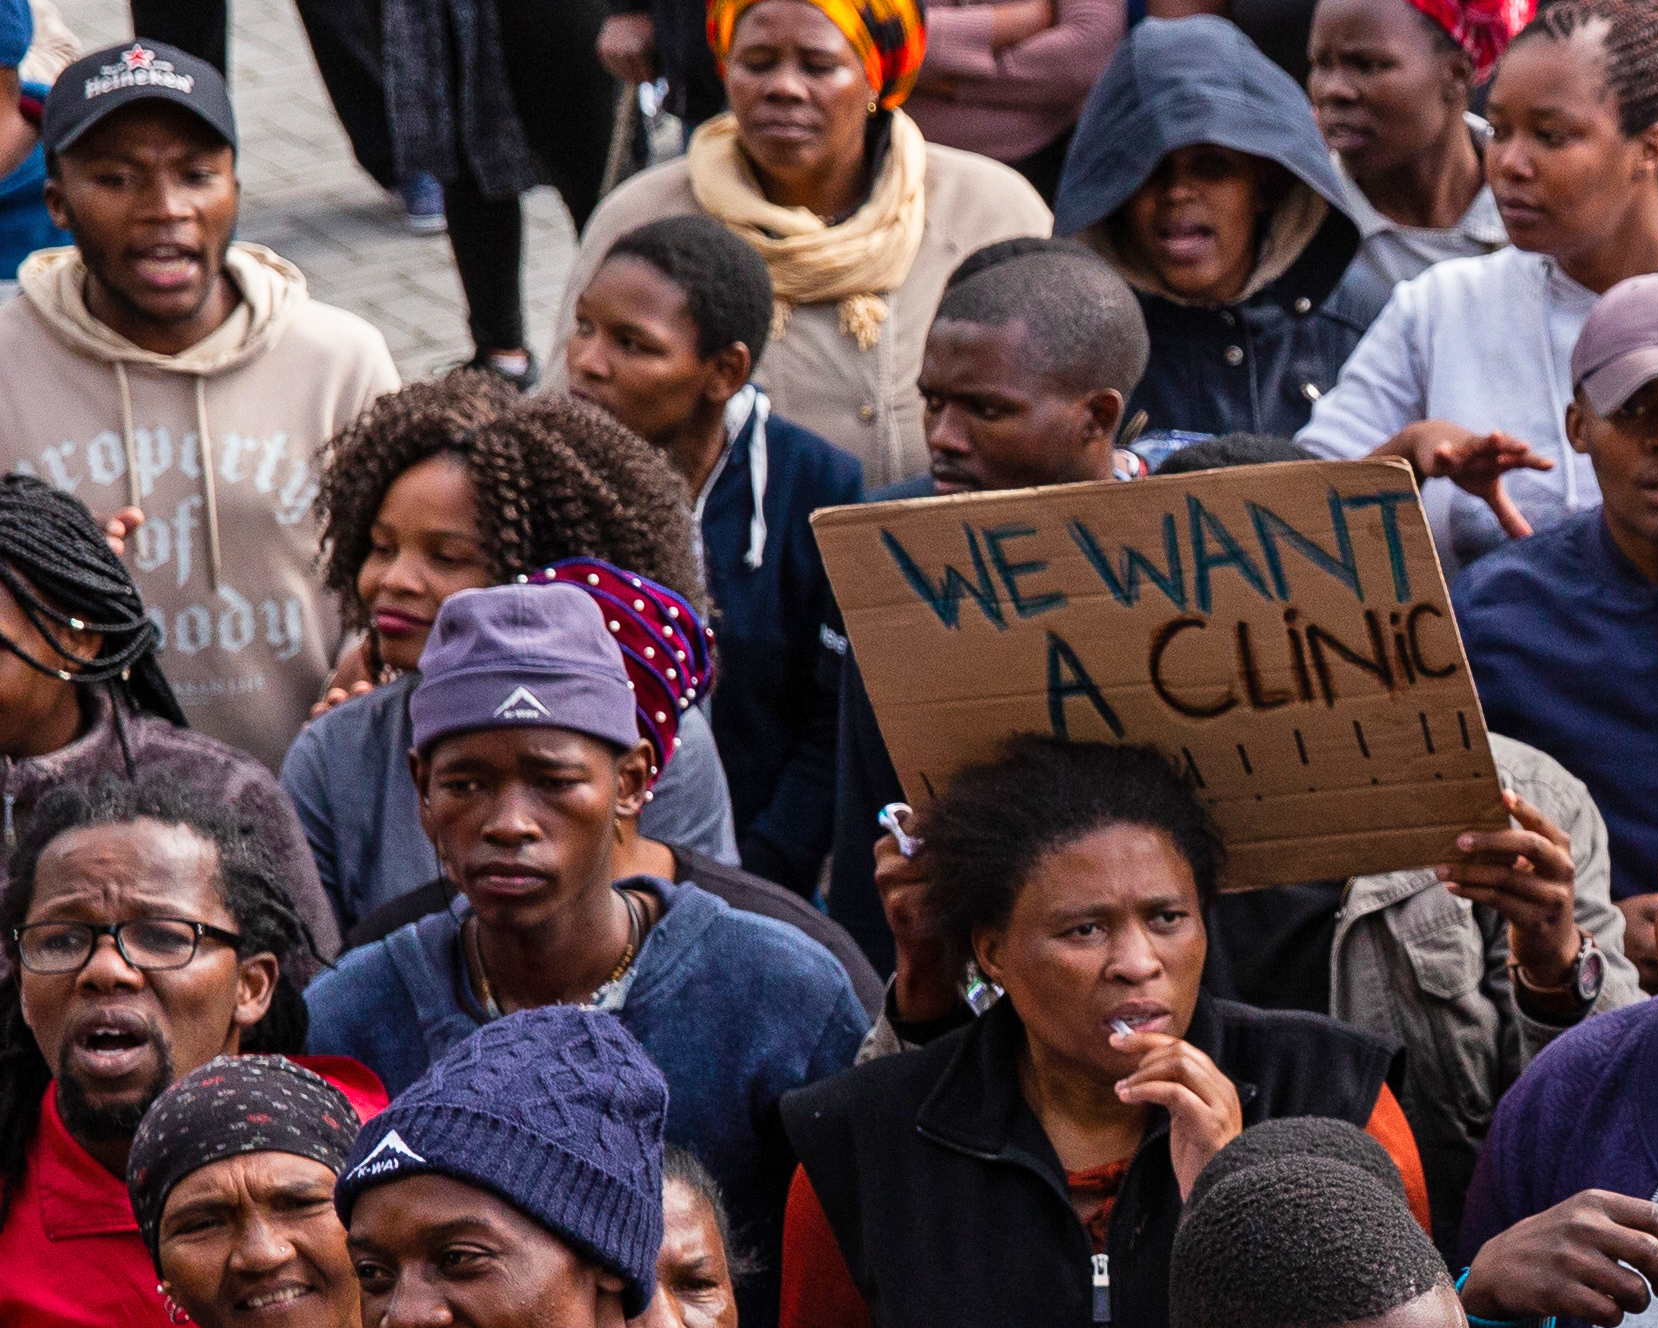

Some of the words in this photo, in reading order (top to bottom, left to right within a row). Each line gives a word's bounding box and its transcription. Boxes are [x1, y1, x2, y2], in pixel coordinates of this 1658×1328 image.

[135, 496, 203, 588] of
[880, 521, 1065, 631] WE
[1068, 488, 1416, 615] WANT
[1046, 631, 1126, 741] A
